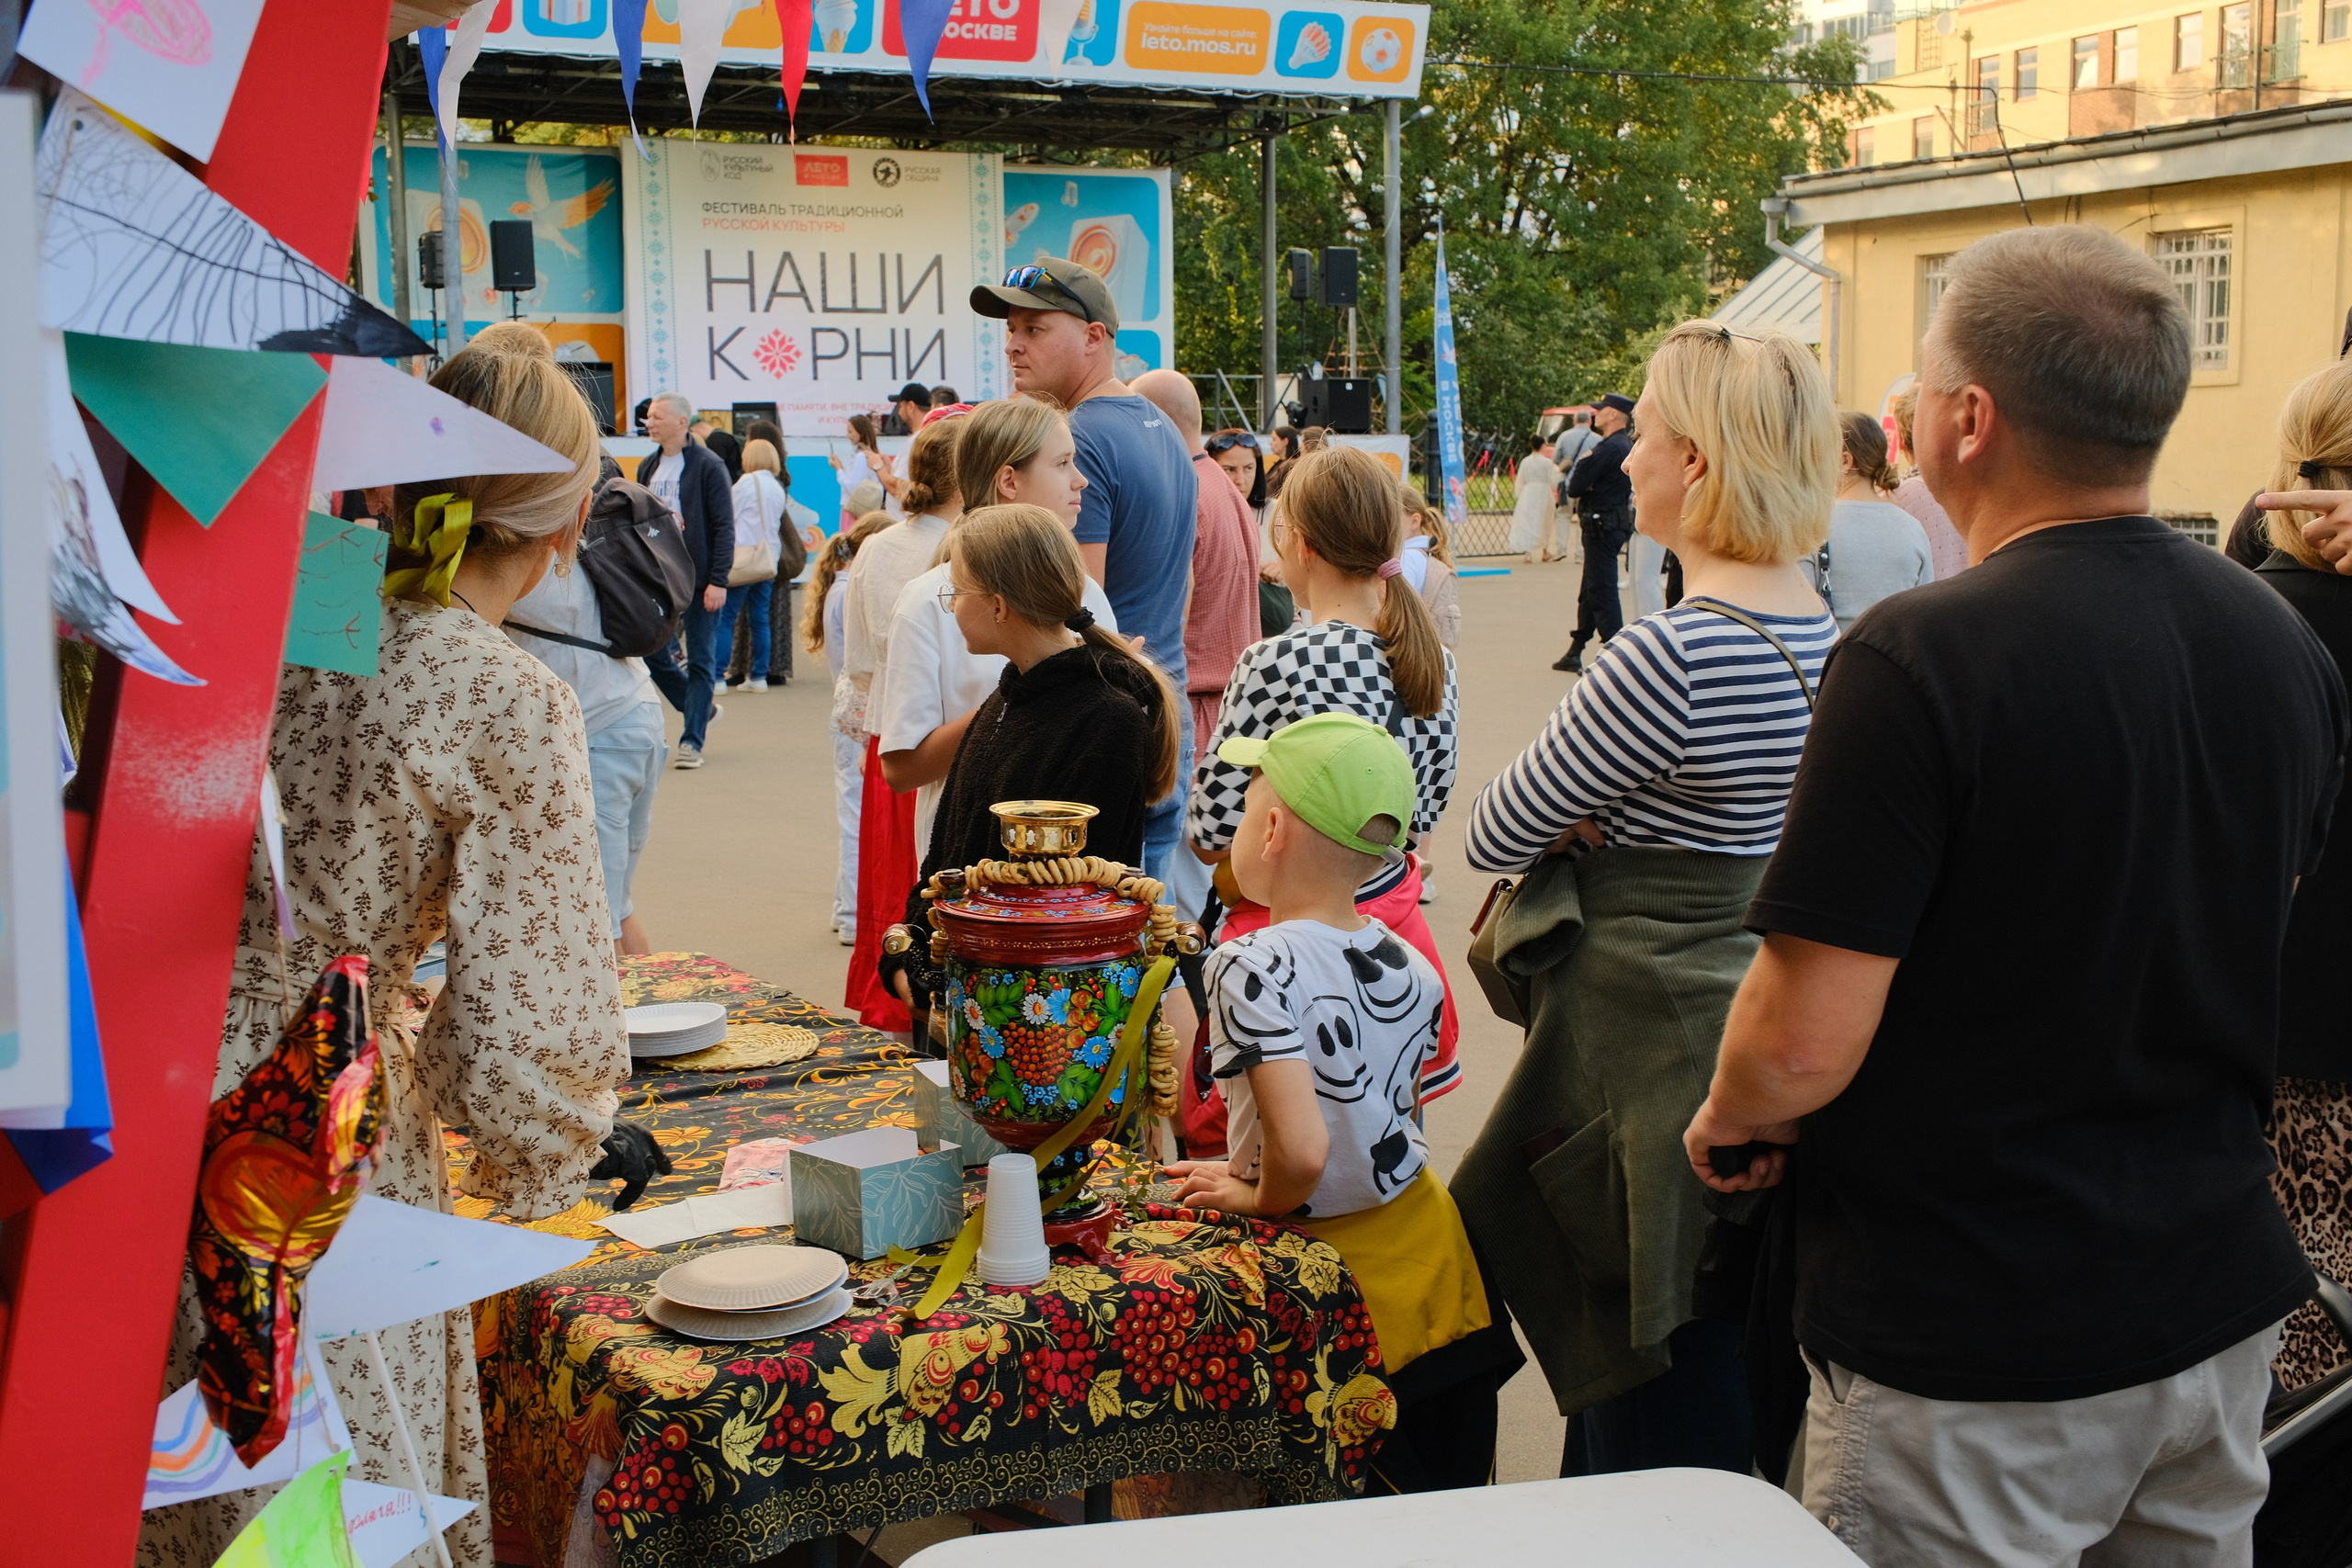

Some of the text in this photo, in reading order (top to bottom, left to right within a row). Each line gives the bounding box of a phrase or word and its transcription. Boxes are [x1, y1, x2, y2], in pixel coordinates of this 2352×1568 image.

[942, 21, 1017, 41] ОСКВЕ
[1141, 32, 1257, 55] leto.mos.ru
[723, 155, 763, 164] РУССКИЙ
[804, 162, 841, 173] ЛЕТО
[905, 165, 941, 175] РУССКАЯ
[724, 172, 741, 180] КОД
[702, 202, 904, 218] ФЕСТИВАЛЬ ТРАДИЦИОННОЙ
[702, 217, 845, 232] РУССКОЙ КУЛЬТУРЫ
[705, 249, 944, 314] НАШИ
[1442, 396, 1457, 463] МОСКВЕ
